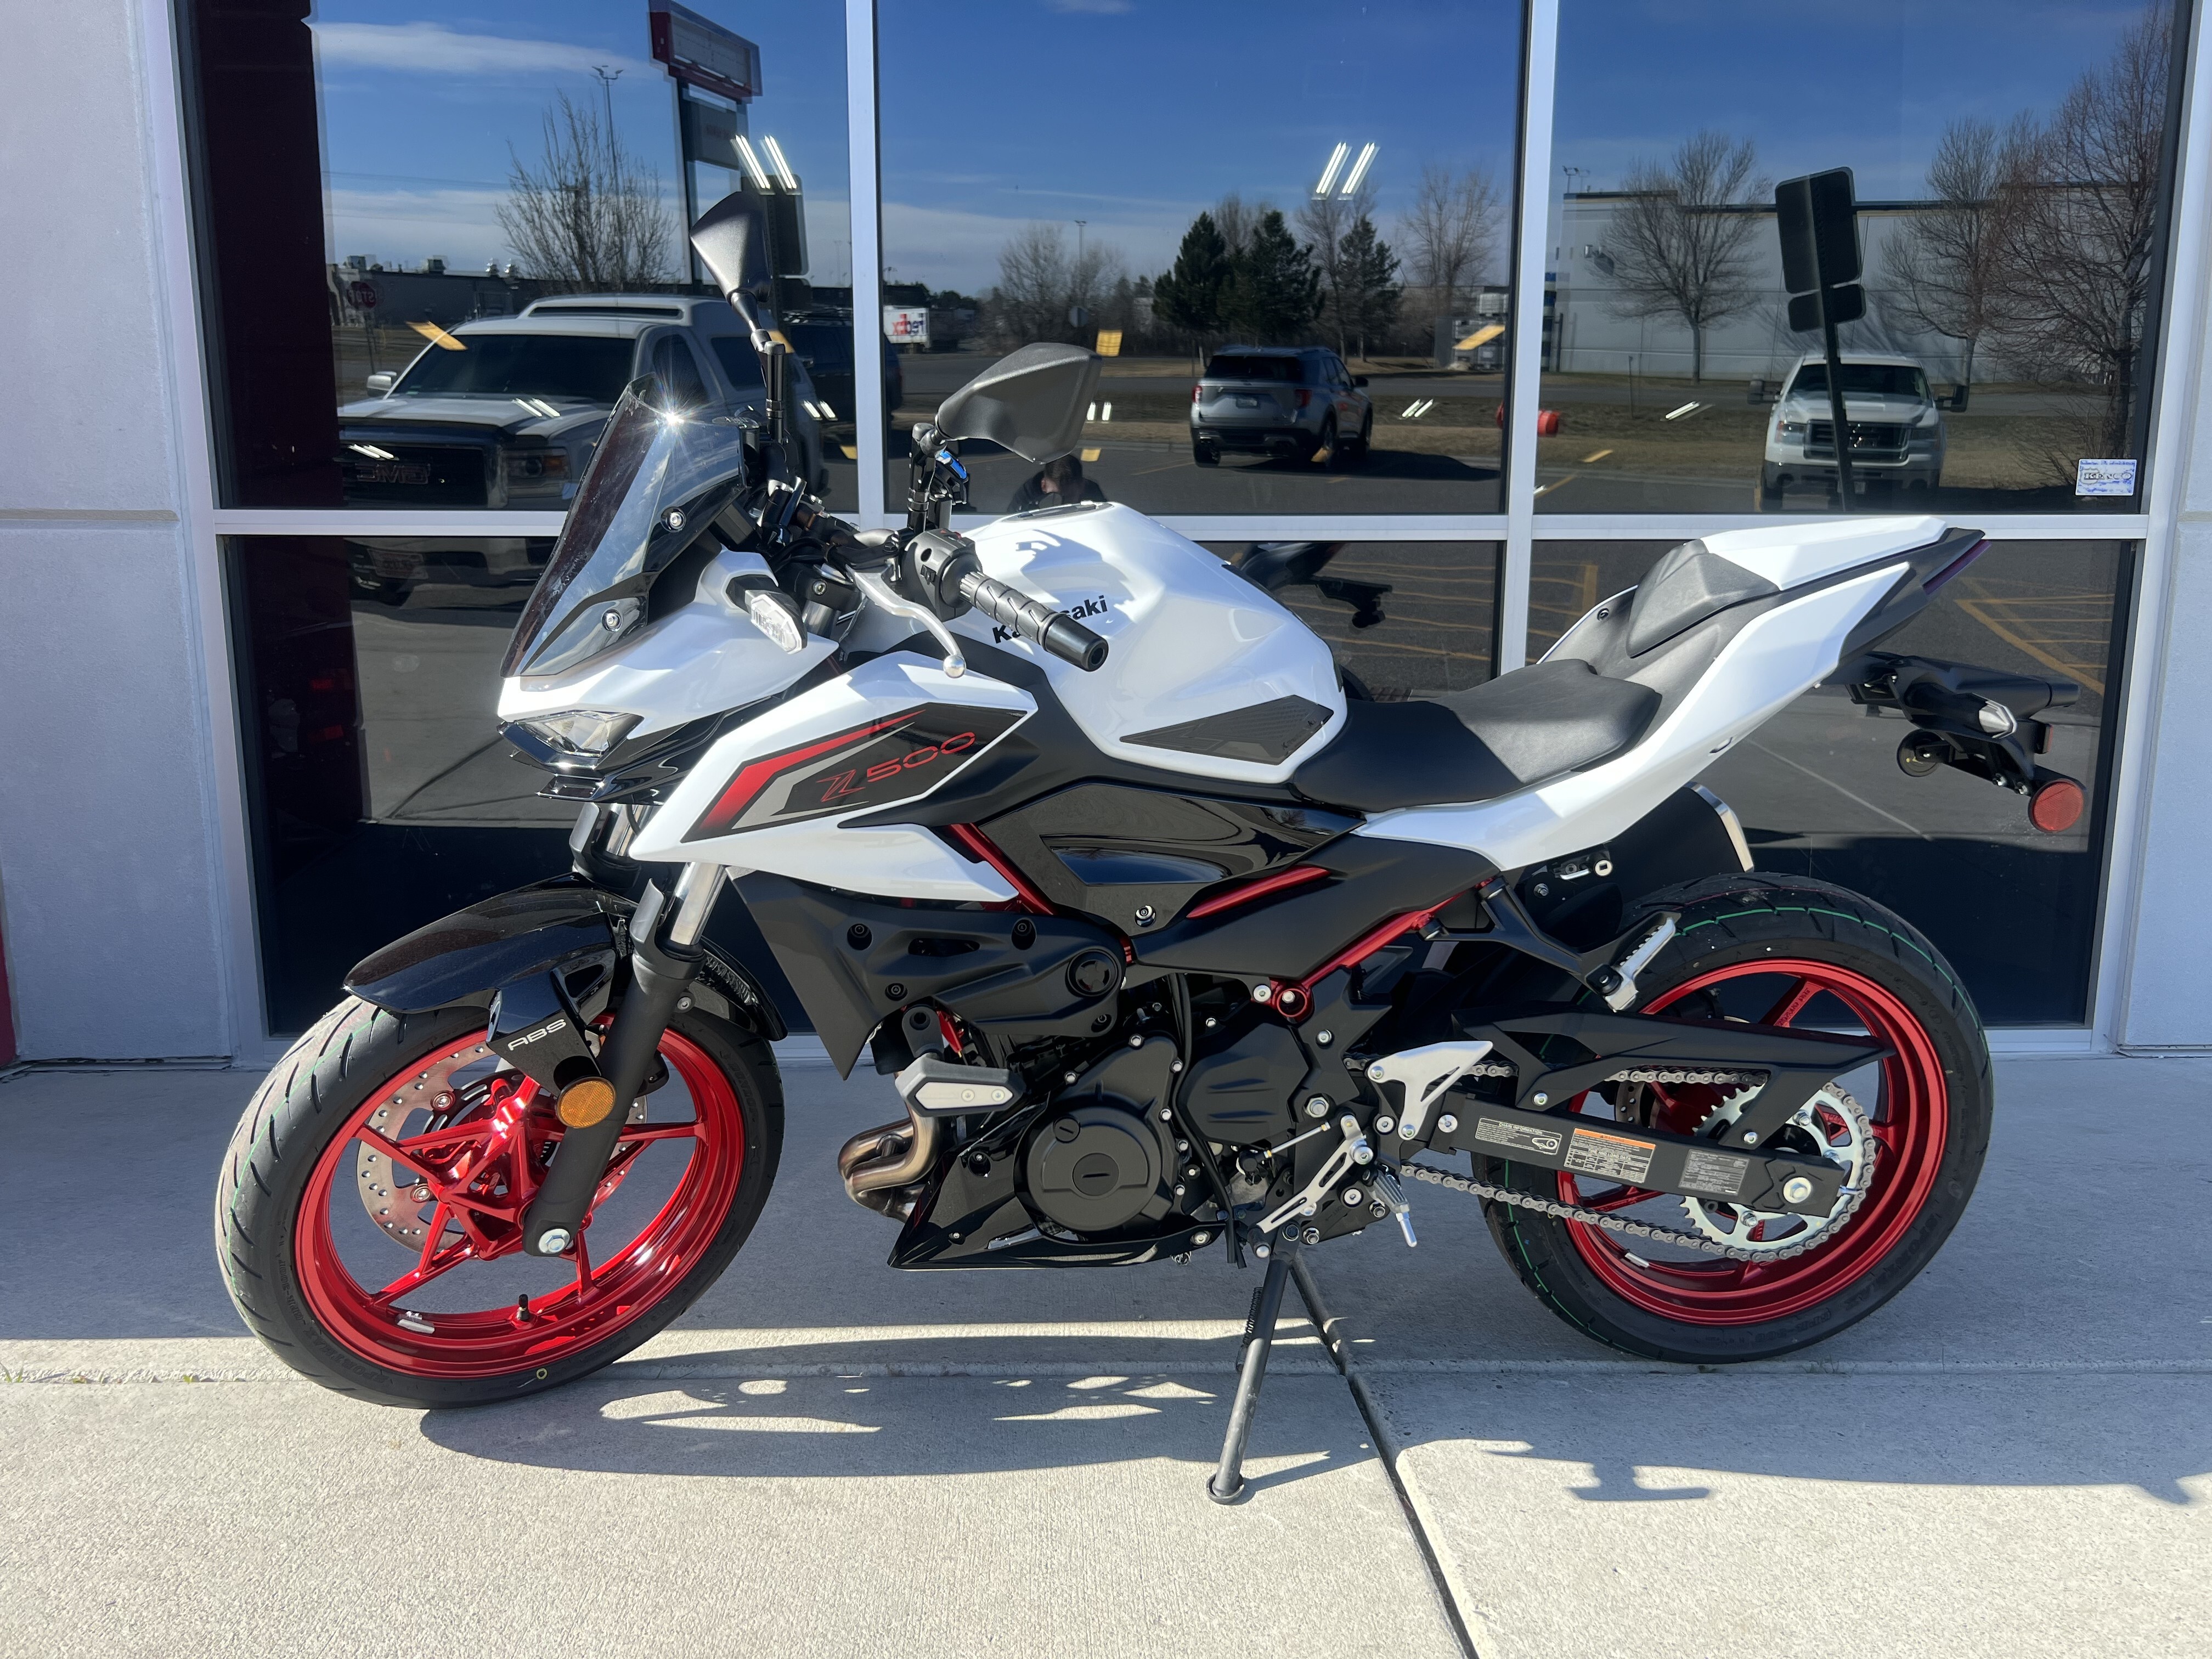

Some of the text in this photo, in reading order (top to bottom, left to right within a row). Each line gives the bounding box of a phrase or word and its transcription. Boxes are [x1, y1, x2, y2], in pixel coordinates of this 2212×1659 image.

[992, 595, 1107, 644] Kaki
[507, 1019, 566, 1051] ABS
[1513, 1125, 1543, 1135] INFORMATION
